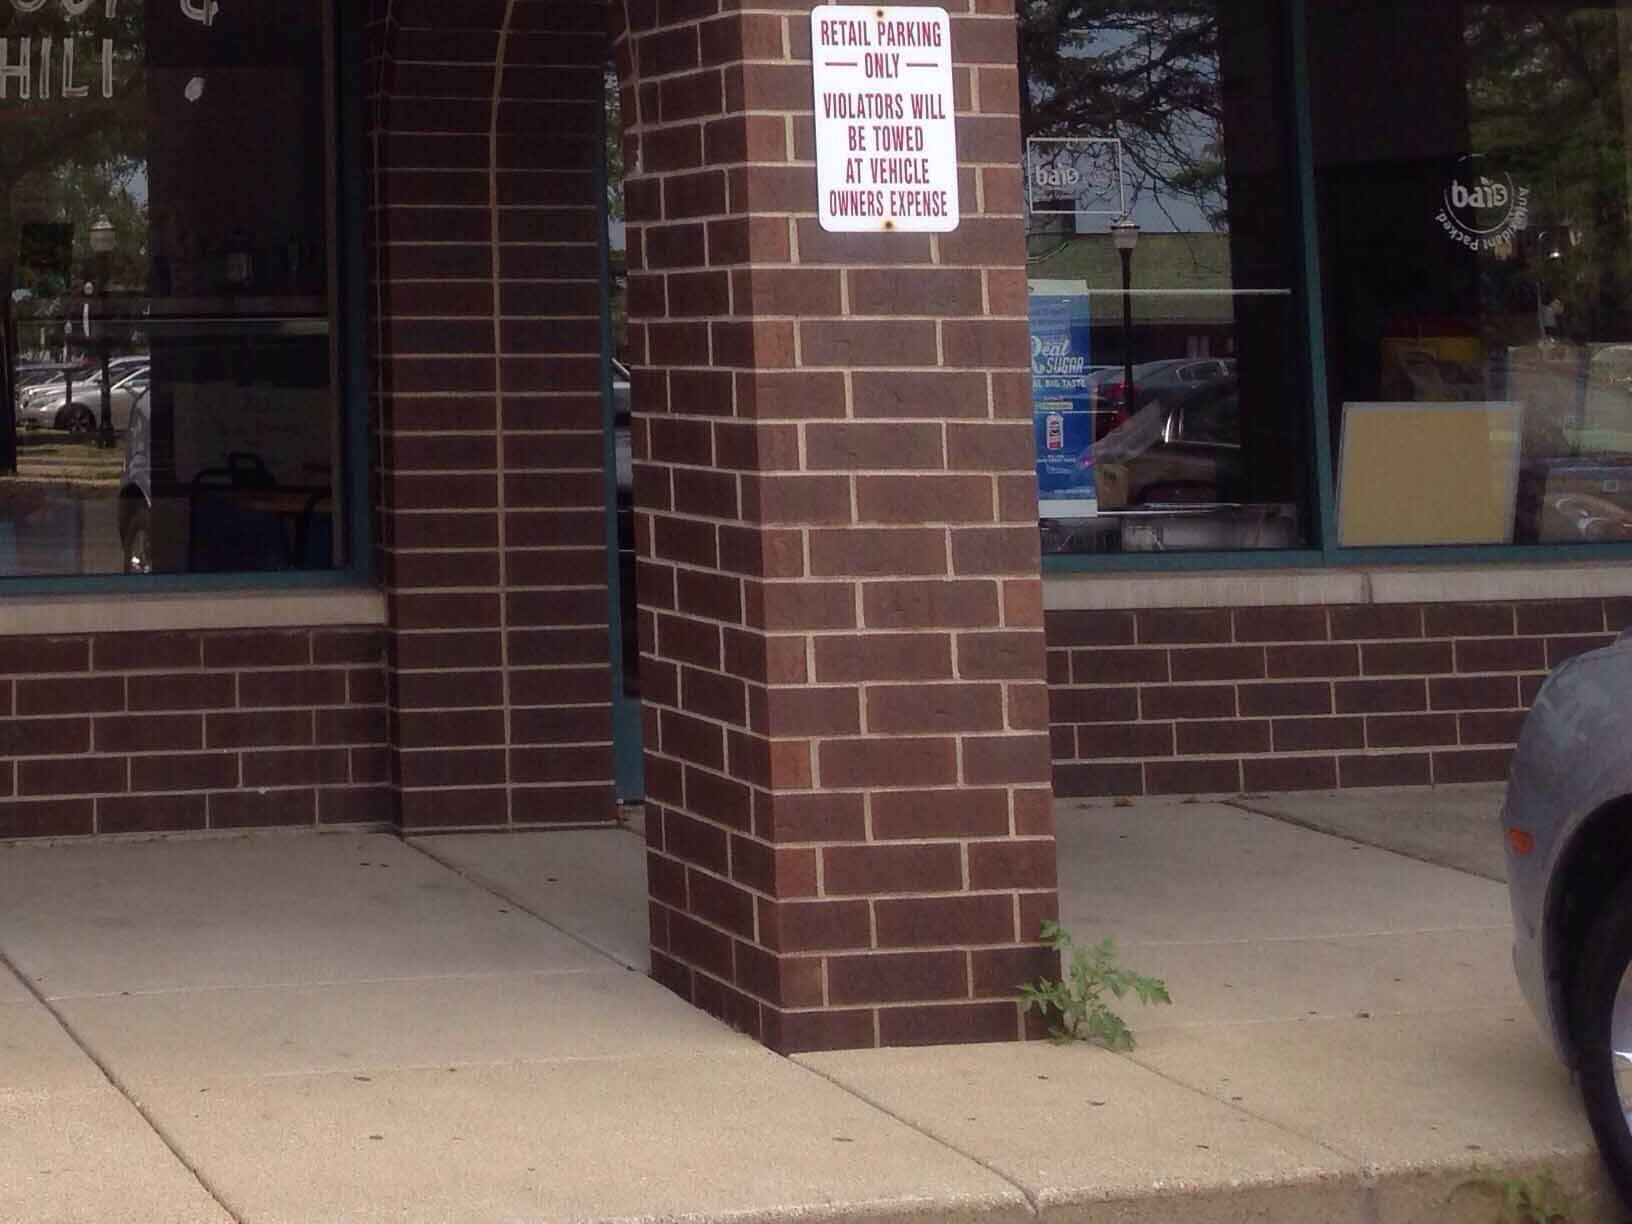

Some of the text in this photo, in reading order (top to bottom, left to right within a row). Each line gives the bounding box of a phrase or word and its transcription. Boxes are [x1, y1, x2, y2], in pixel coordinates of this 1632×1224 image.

[821, 20, 941, 47] RETAIL PARKING
[864, 52, 900, 79] ONLY
[823, 92, 946, 120] VIOLATORS WILL
[848, 126, 924, 152] BE TOWED
[846, 158, 930, 184] AT VEHICLE
[829, 190, 948, 217] OWNERS EXPENSE
[1046, 357, 1084, 374] SUGAR
